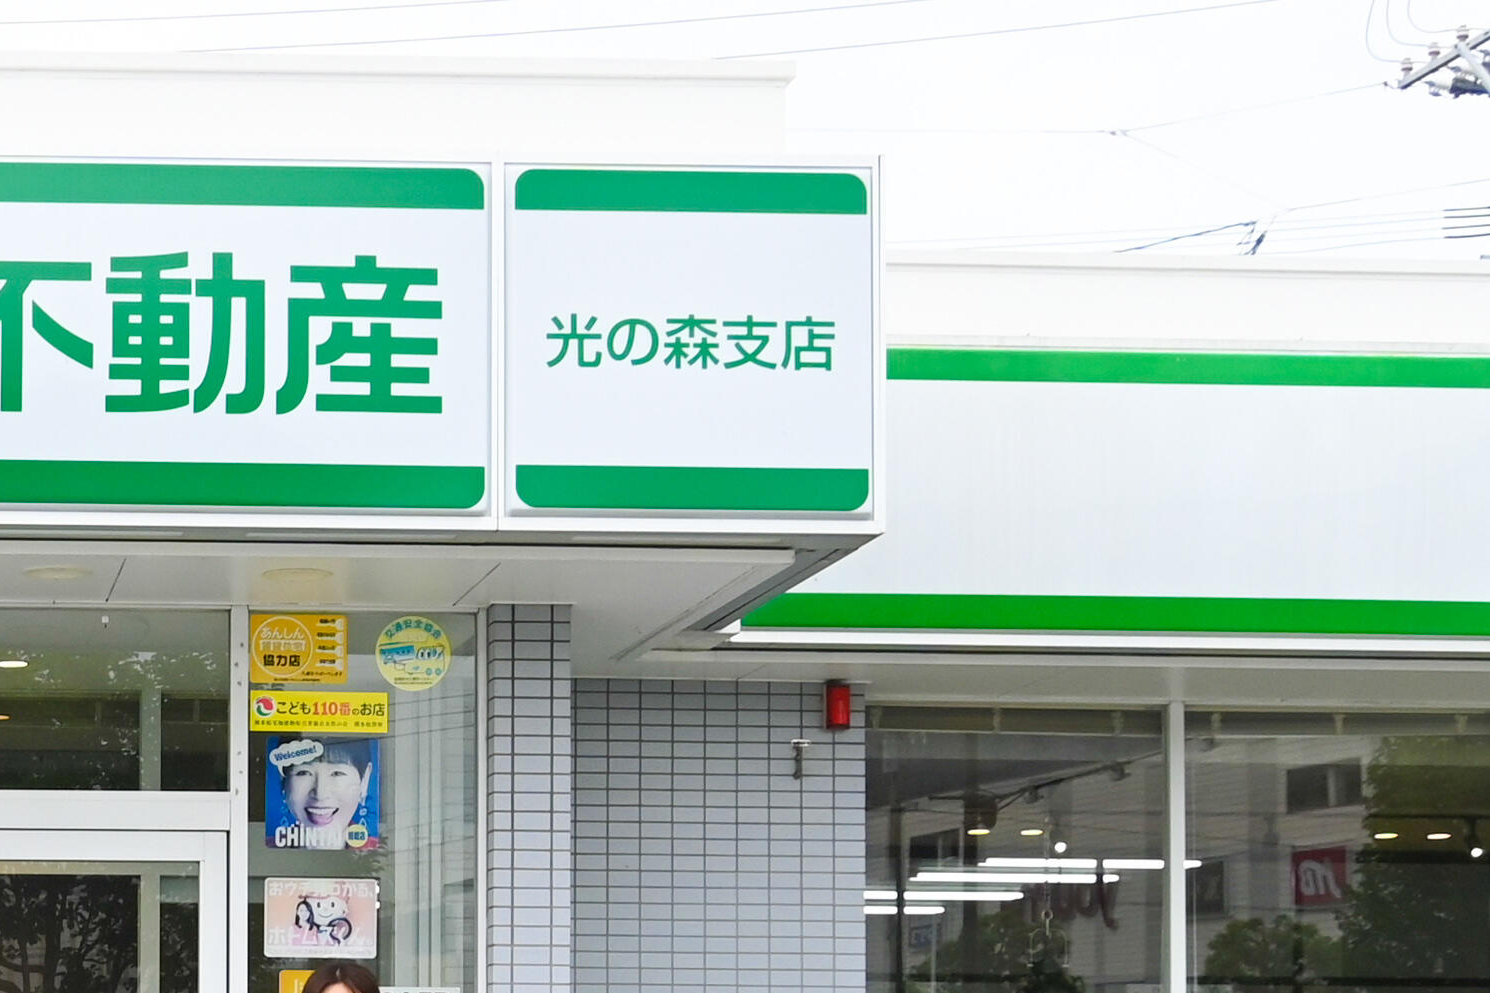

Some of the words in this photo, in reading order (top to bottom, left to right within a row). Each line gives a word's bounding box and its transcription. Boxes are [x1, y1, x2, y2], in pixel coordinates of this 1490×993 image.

[546, 314, 836, 371] 光の森支店
[263, 654, 301, 667] 協力店
[276, 700, 386, 717] こども110番のお店
